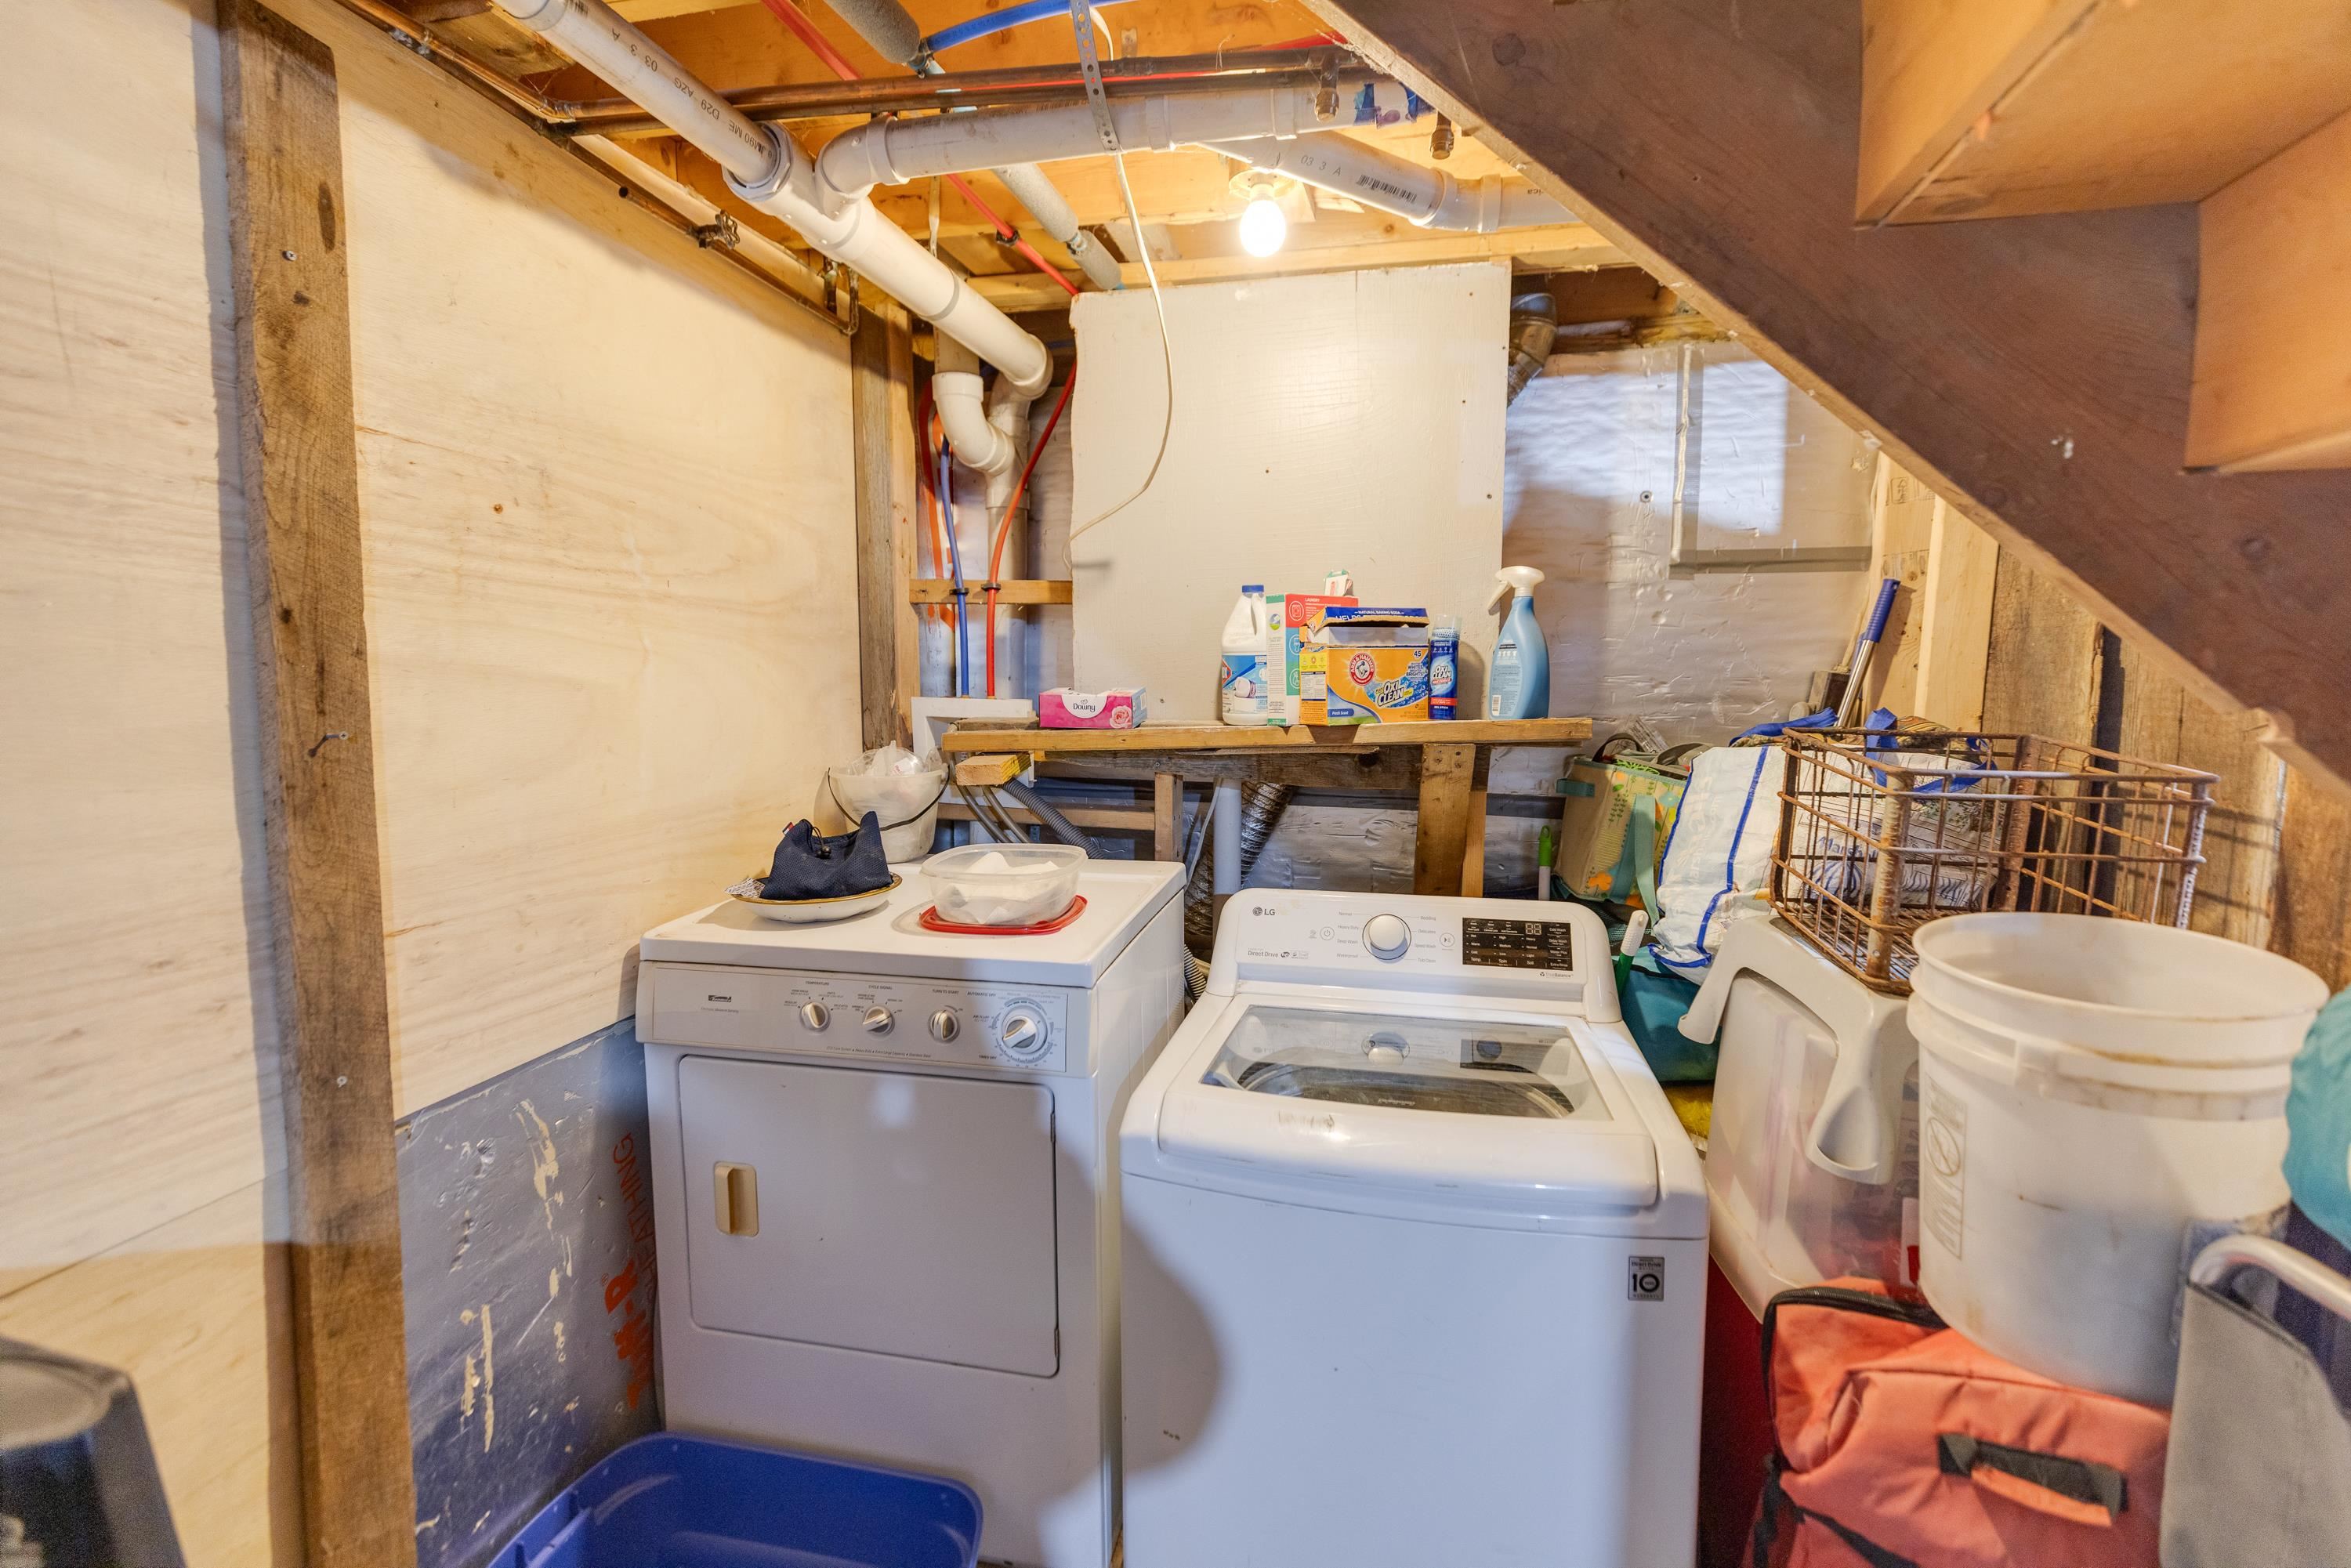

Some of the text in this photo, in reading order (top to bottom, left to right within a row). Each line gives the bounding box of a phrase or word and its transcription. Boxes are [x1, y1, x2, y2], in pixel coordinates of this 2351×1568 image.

[612, 28, 621, 41] A
[630, 44, 638, 56] 3
[644, 55, 657, 72] 03
[701, 99, 720, 120] D29
[1300, 155, 1342, 176] 03 3 A
[1384, 680, 1400, 694] OXI
[1378, 686, 1405, 707] CLEAN
[1073, 703, 1096, 712] Downy
[1632, 1273, 1661, 1293] 10
